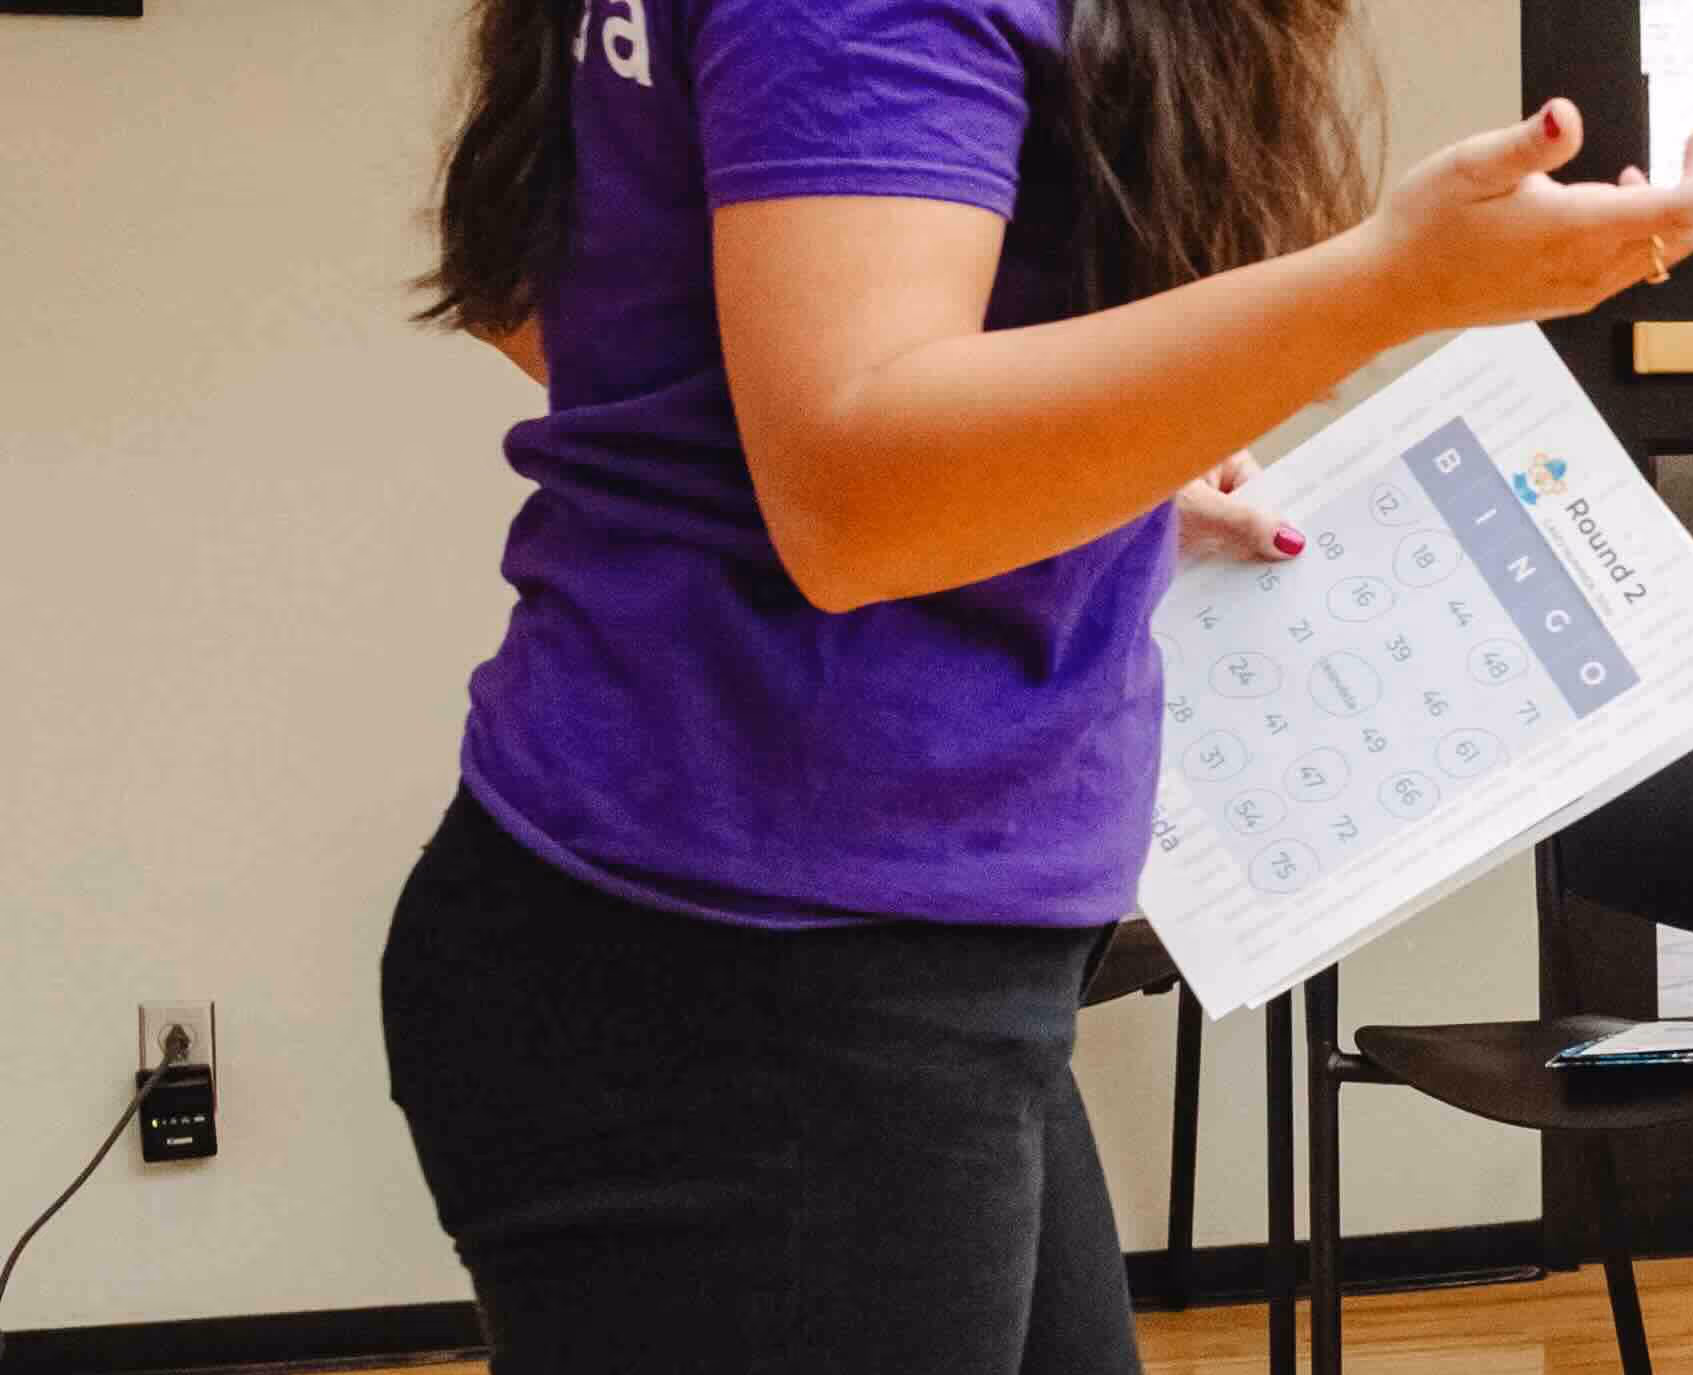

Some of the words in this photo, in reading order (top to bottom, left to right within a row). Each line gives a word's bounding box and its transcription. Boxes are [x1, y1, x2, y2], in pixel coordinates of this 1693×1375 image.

[1317, 531, 1344, 561] 08
[1351, 582, 1376, 607] 16
[1385, 635, 1412, 663] 39
[1423, 690, 1449, 718] 46
[1455, 740, 1481, 765] 61
[1375, 491, 1399, 517] 12
[1411, 543, 1436, 569] 18
[1448, 600, 1472, 627] 44
[1483, 652, 1510, 679] 48
[1517, 700, 1541, 726] 71
[1565, 497, 1635, 582] Round
[1622, 583, 1648, 605] 2
[1167, 695, 1194, 724] 28
[1234, 798, 1260, 828] 54
[1270, 851, 1297, 881] 75
[1196, 605, 1220, 631] 14
[1228, 656, 1255, 686] 24
[1265, 713, 1289, 736] 41
[1301, 766, 1327, 788] 47
[1332, 815, 1359, 843] 72
[1288, 618, 1315, 644] 21
[1361, 728, 1388, 754] 49
[1394, 777, 1423, 807] 66
